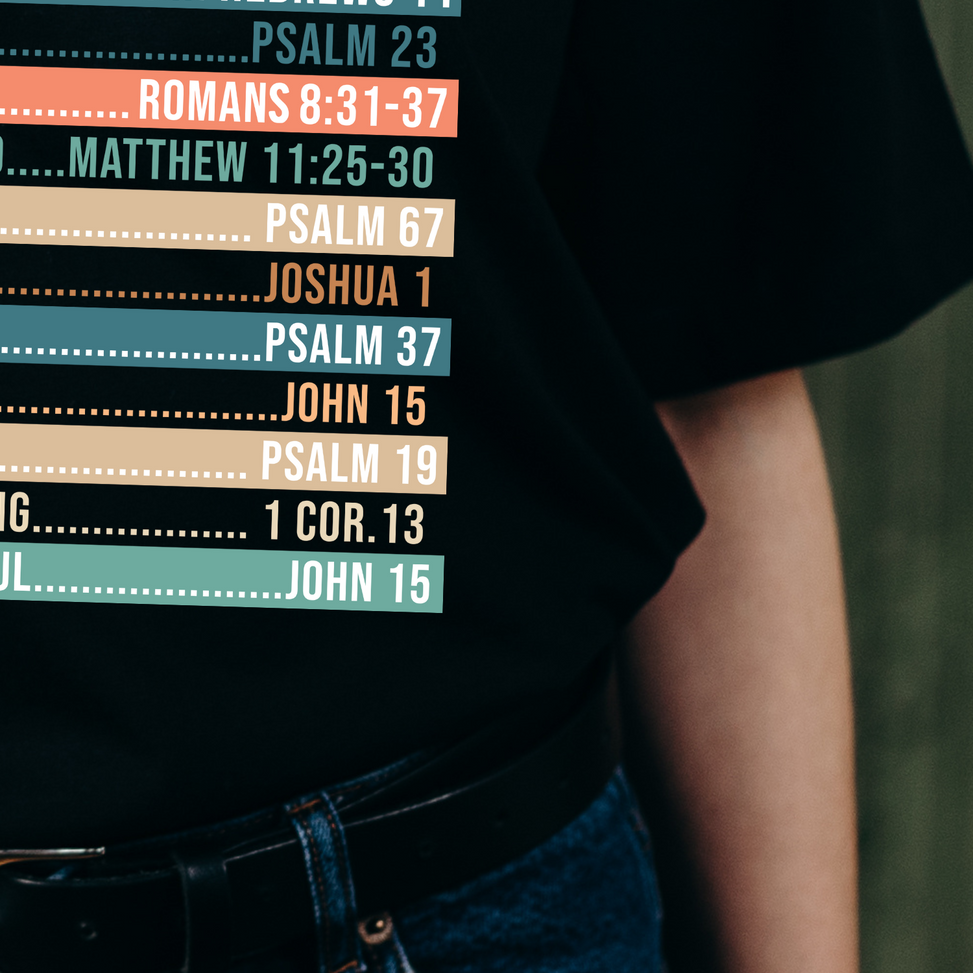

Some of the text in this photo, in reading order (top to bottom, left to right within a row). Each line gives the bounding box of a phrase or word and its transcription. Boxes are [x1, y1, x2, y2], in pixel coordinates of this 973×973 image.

[252, 20, 376, 67] PSALM
[391, 24, 437, 69] 23
[139, 78, 290, 124] ROMANS
[299, 83, 448, 129] 8:31-37
[69, 136, 248, 183] MATTHEW
[264, 142, 434, 189] 11:25-30
[266, 202, 385, 246] PSALM
[399, 206, 444, 248] 67
[263, 261, 399, 307] JOSHUA
[415, 266, 430, 308] 1
[265, 322, 383, 365] PSALM
[397, 325, 441, 367] 37
[280, 381, 369, 424] JOHN
[385, 384, 426, 426] 15
[261, 440, 379, 484] PSALM
[396, 444, 437, 486] 19
[265, 499, 280, 541] 1
[285, 560, 373, 602] JOHN
[389, 563, 430, 604] 15
